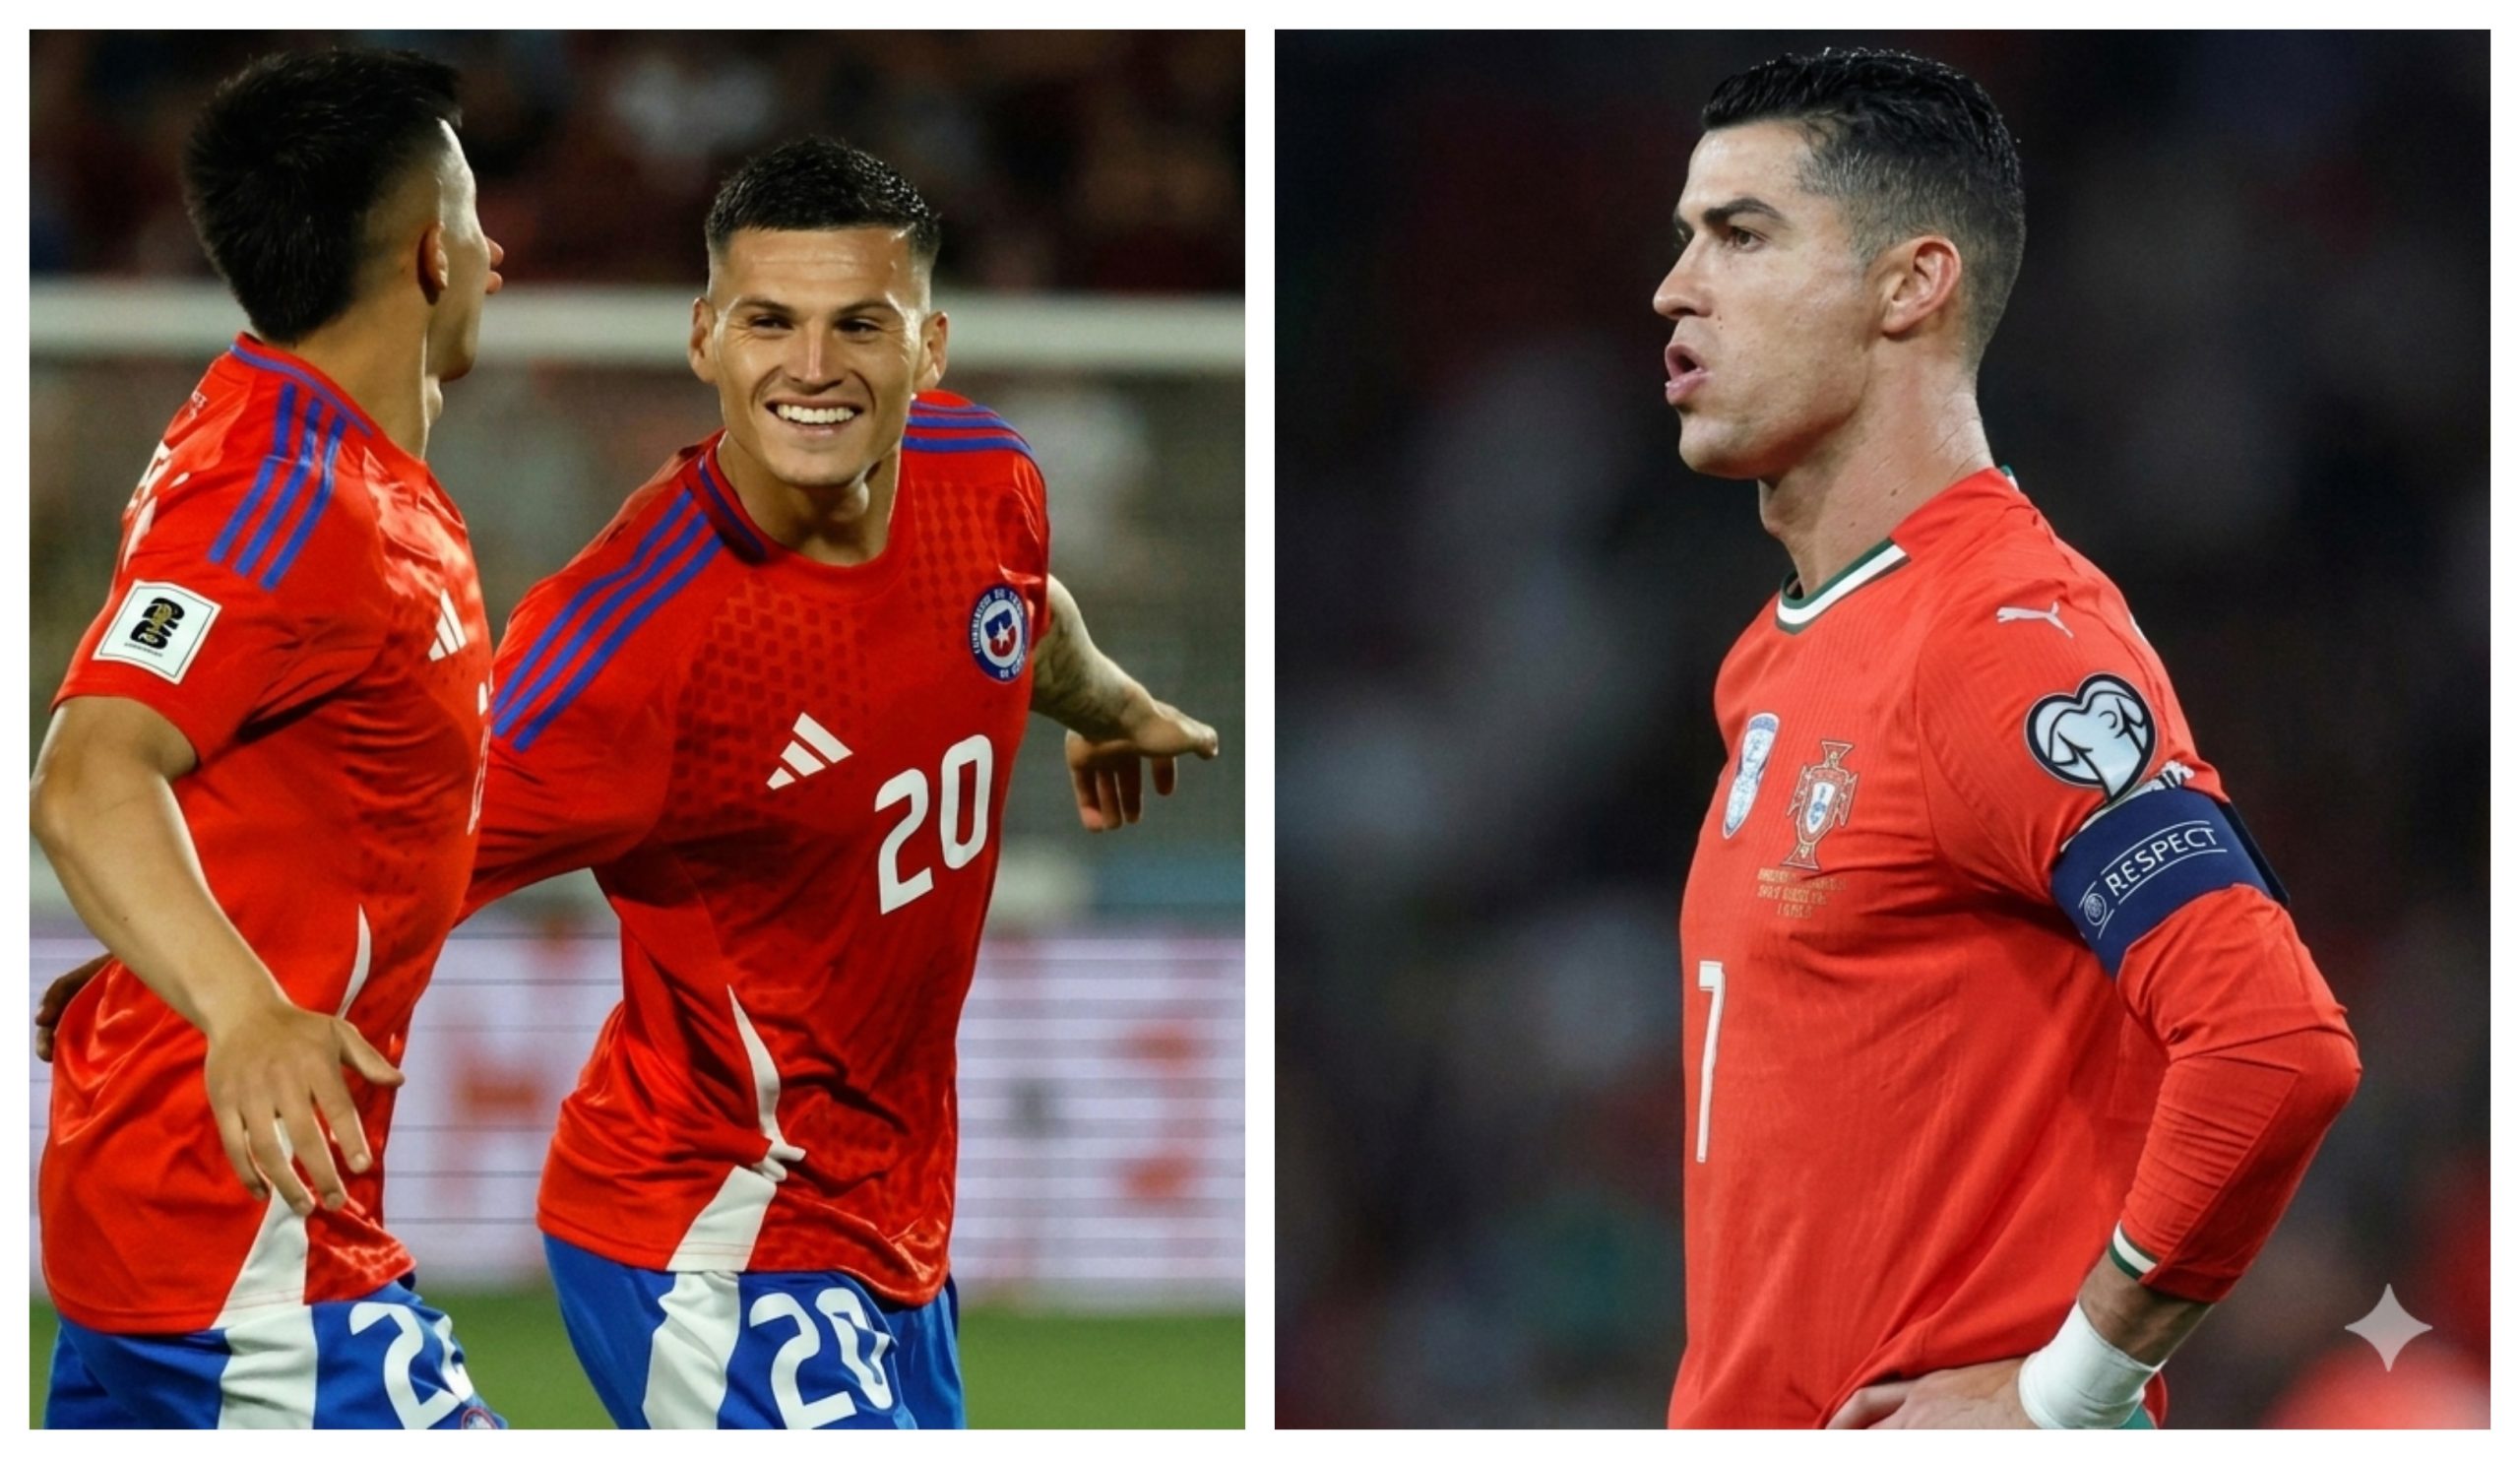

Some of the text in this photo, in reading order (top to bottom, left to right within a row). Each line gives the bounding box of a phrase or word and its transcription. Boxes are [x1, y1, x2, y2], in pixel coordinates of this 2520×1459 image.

[874, 733, 993, 916] 20
[2105, 827, 2218, 897] RESPECT
[1696, 960, 1726, 1164] 7
[749, 1288, 894, 1428] 20
